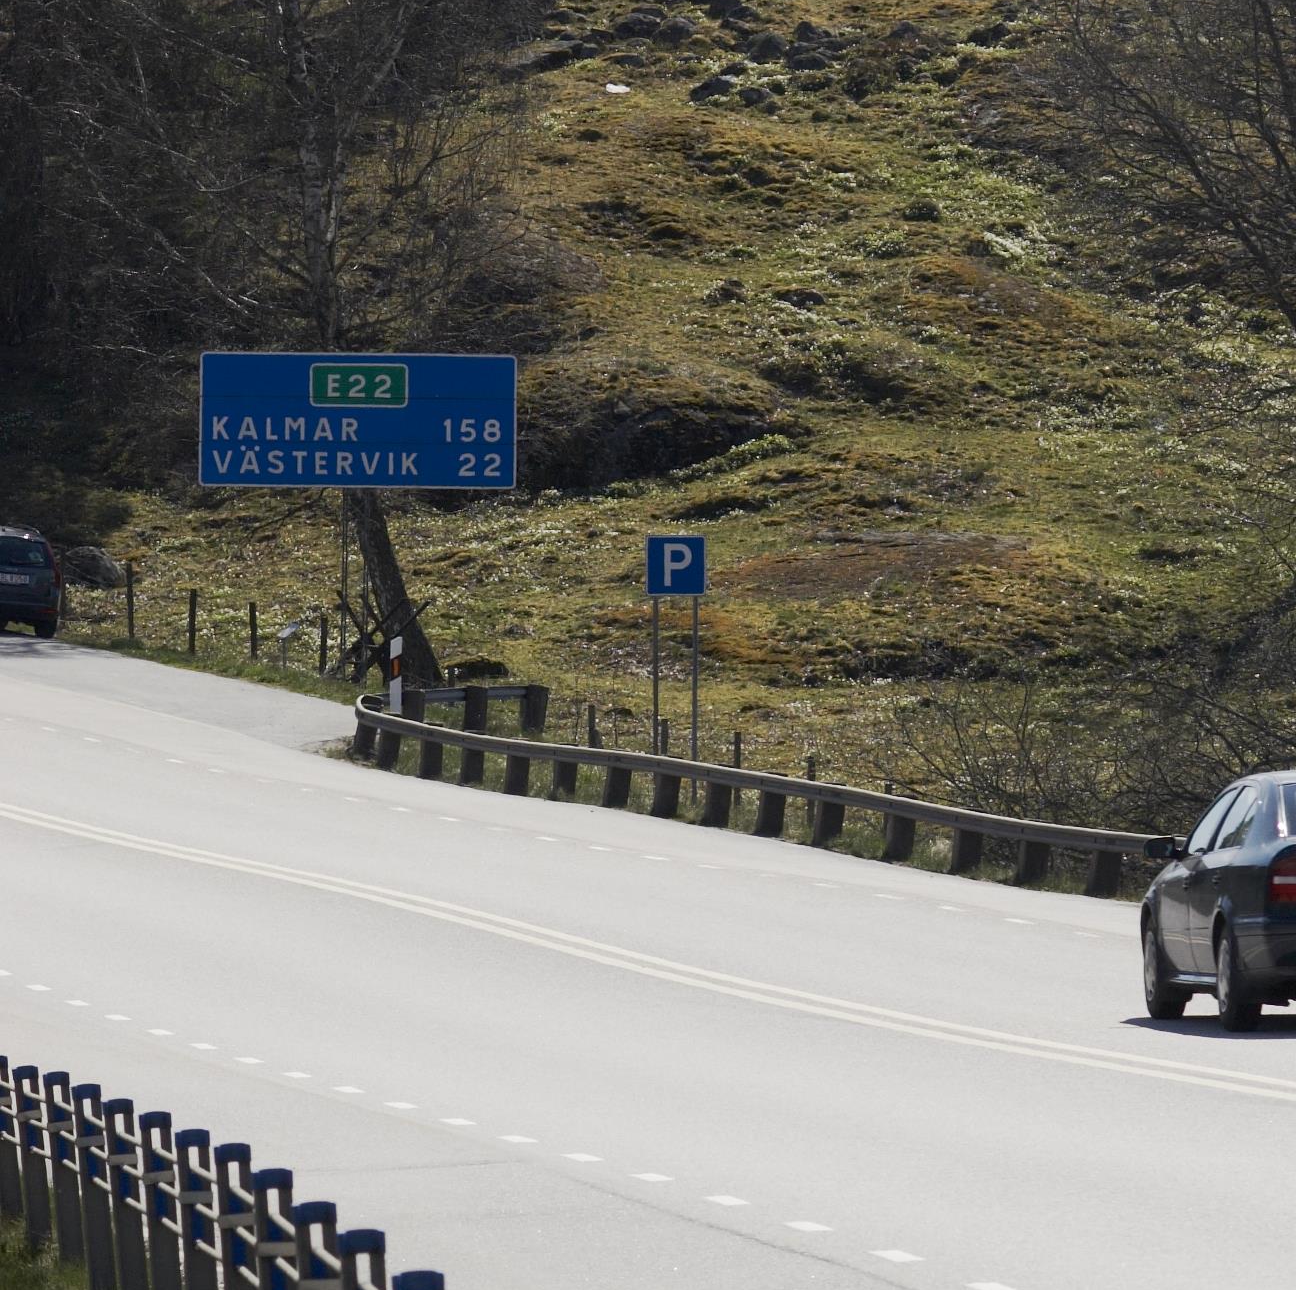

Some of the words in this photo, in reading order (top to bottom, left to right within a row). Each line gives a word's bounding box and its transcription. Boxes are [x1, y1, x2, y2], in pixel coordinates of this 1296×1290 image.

[327, 373, 392, 398] E22
[212, 416, 359, 441] KALMAR
[443, 418, 501, 443] 158
[213, 445, 418, 475] VÄSTERVIK
[458, 453, 501, 476] 22
[663, 543, 692, 586] P
